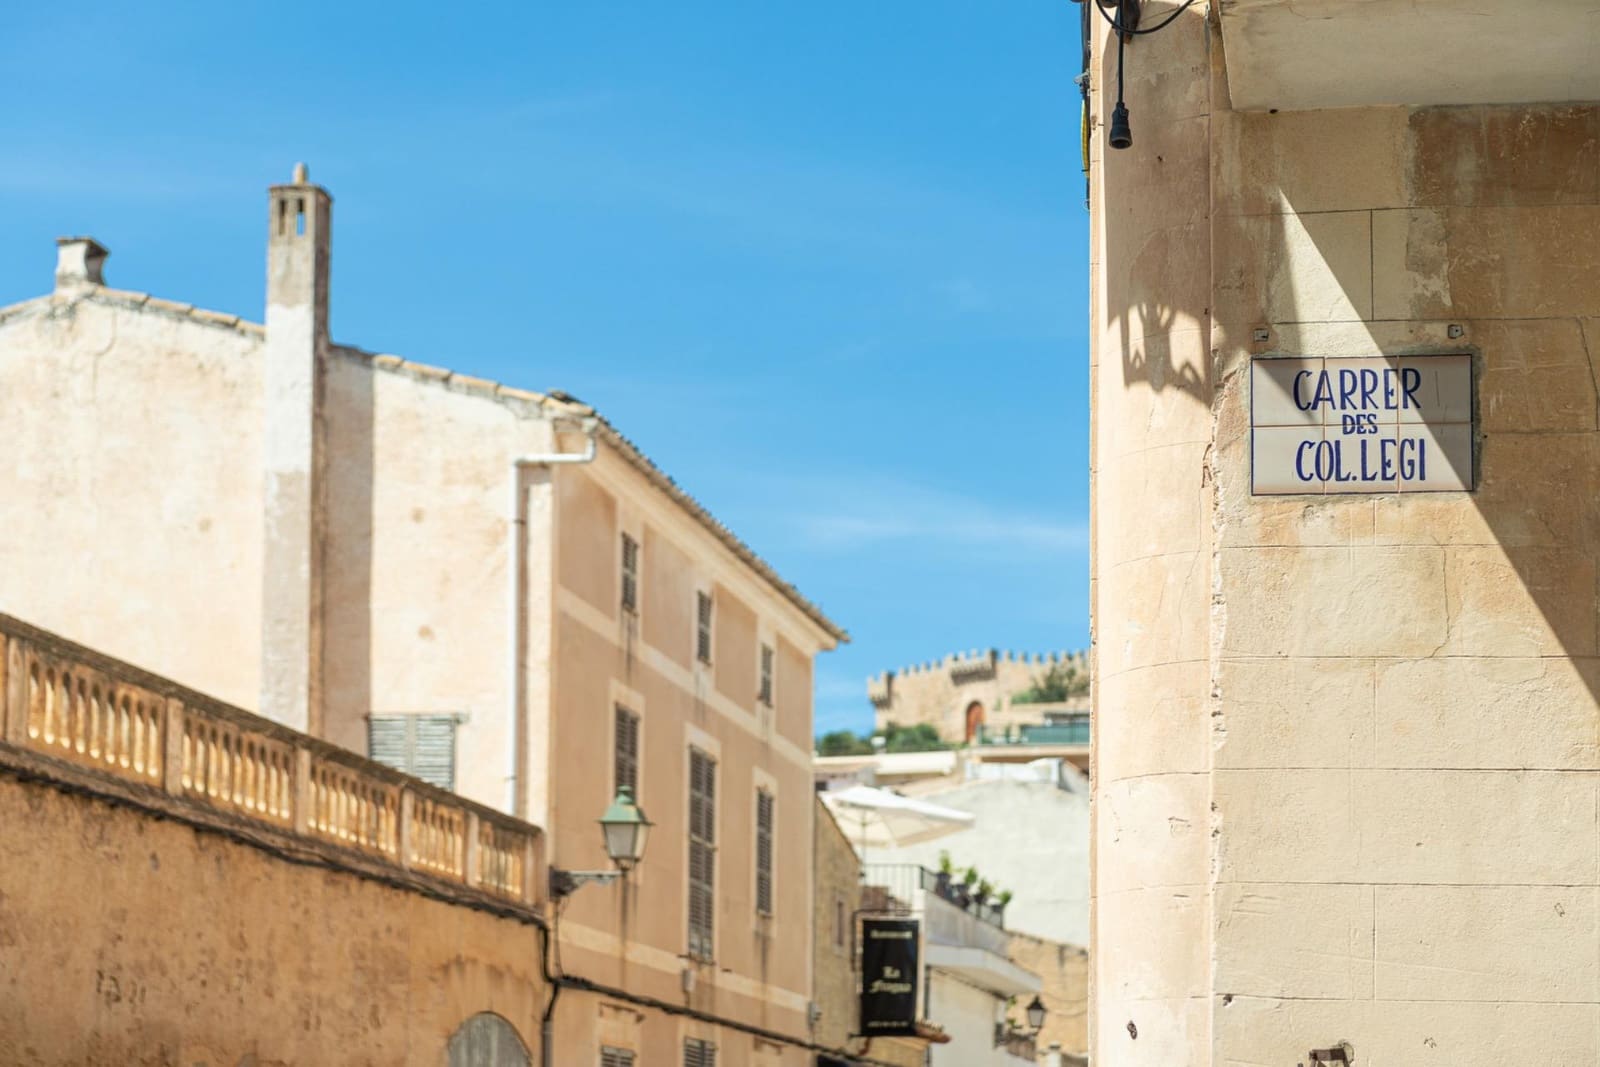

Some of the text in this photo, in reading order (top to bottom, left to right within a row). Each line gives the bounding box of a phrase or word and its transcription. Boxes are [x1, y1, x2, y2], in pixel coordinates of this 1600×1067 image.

[1293, 368, 1422, 411] CARRER
[1342, 414, 1378, 435] DES
[1296, 438, 1425, 481] COL.LEGI
